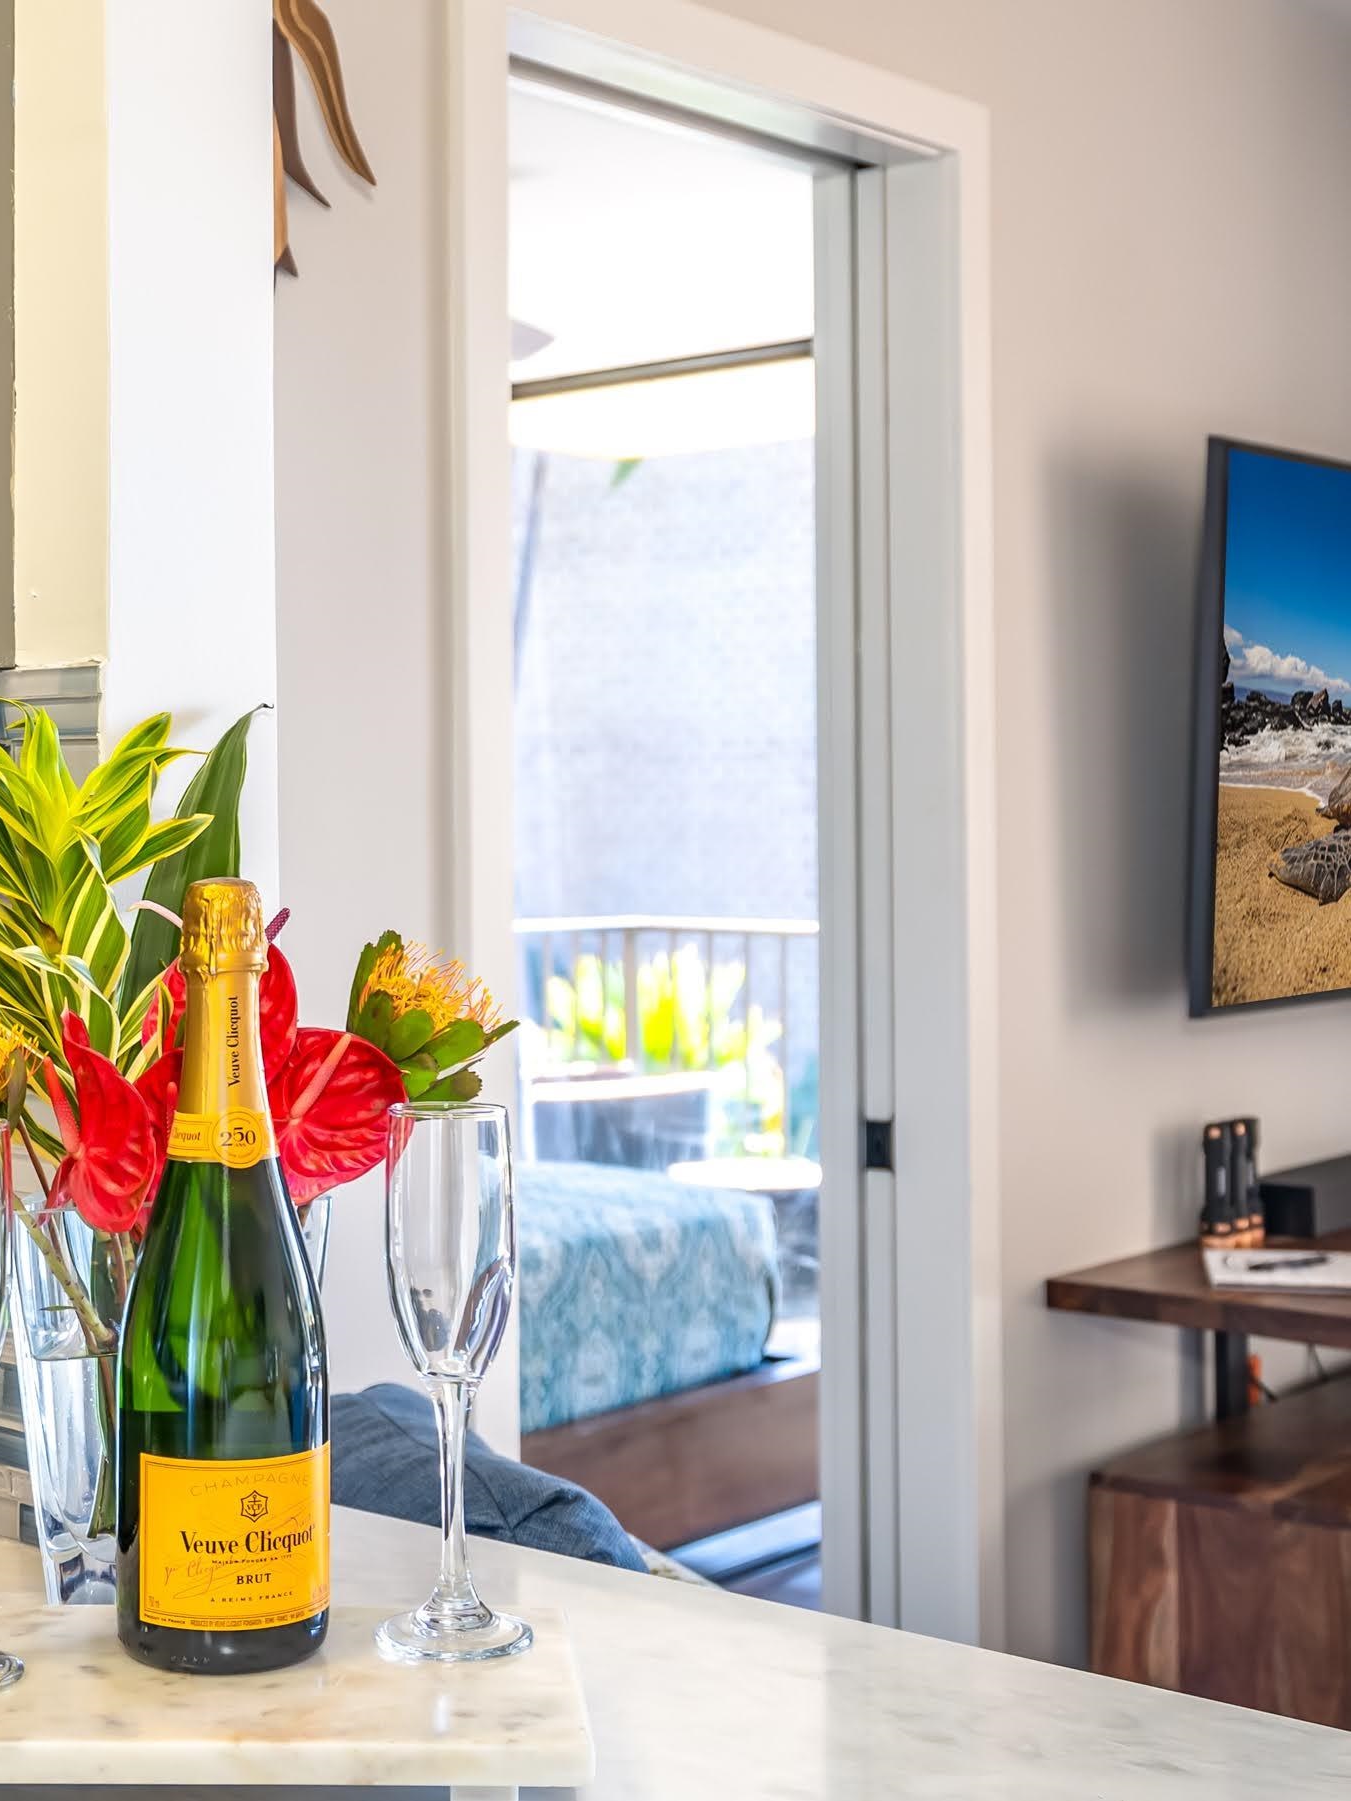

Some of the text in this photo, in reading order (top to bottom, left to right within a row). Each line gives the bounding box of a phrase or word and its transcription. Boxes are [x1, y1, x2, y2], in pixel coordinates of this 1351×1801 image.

[226, 996, 241, 1087] Veuve Clicquot
[220, 1126, 256, 1147] 250
[189, 1472, 310, 1497] CHAMPAGNE
[180, 1524, 313, 1554] Veuve Clicquot
[236, 1572, 271, 1585] BRUT
[259, 1591, 293, 1600] FRANCE
